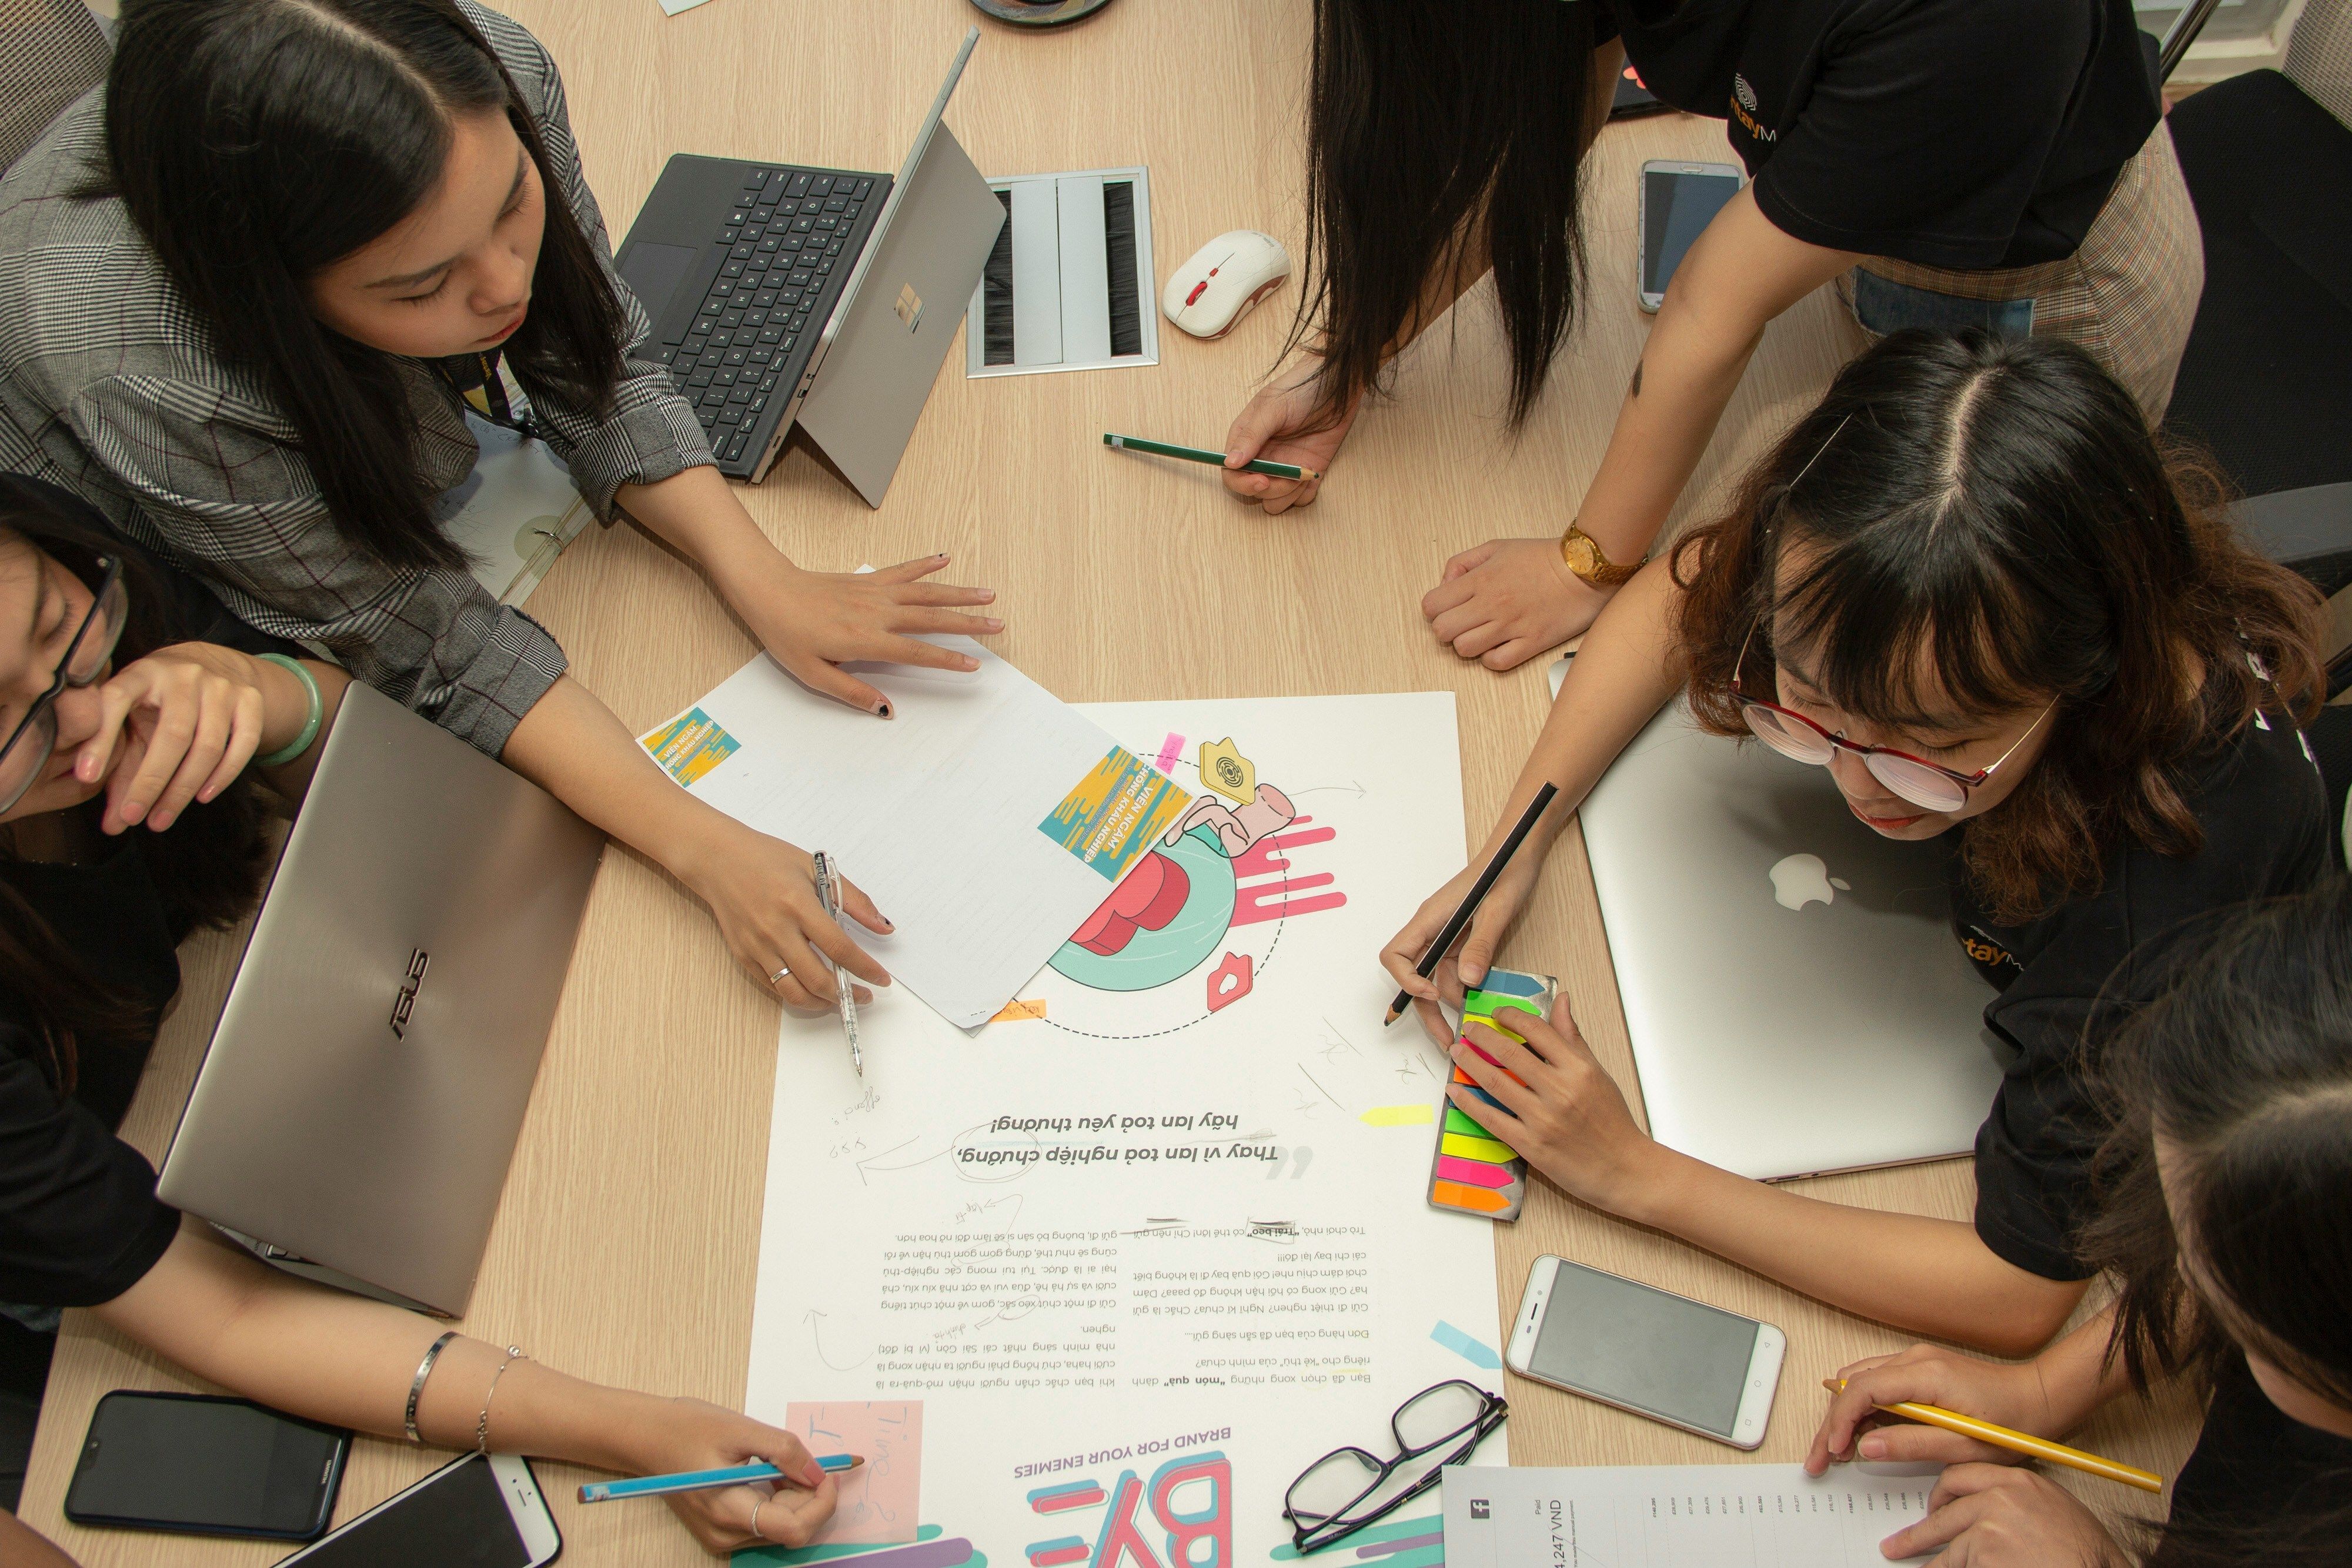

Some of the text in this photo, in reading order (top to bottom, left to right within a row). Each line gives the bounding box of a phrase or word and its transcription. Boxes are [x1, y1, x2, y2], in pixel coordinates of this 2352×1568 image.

[664, 744, 680, 758] VIÊN
[1107, 796, 1130, 828] KHẨU
[1107, 785, 1154, 850] VIÊN NGẬM
[1084, 824, 1111, 864] NGHIỆP
[389, 947, 430, 1043] ASUS
[990, 1111, 1239, 1134] hãy lan toả yêu thương!
[957, 1143, 1279, 1166] Thay vì lan toả nghiệp chướng,
[1133, 1305, 1149, 1316] gửi
[1152, 1306, 1161, 1315] là
[1165, 1306, 1191, 1316] Chắc
[1194, 1306, 1224, 1315] chưa?
[1227, 1306, 1236, 1314] kĩ
[1240, 1303, 1264, 1314] Nghĩ
[1268, 1302, 1307, 1313] nghen?
[1311, 1303, 1334, 1313] thiệt
[1351, 1303, 1368, 1313] Gửi
[1080, 1324, 1115, 1335] nghen.
[1275, 1329, 1294, 1340] bạn
[1318, 1329, 1345, 1339] hàng
[1348, 1330, 1369, 1339] Đơn
[1212, 1330, 1237, 1340] sàng
[1240, 1332, 1257, 1342] sẵn
[1259, 1332, 1272, 1340] đã
[1297, 1330, 1316, 1340] của
[878, 1344, 898, 1355] đốt)
[904, 1344, 913, 1354] bị
[936, 1345, 957, 1353] Gòn
[963, 1345, 977, 1353] Sài
[983, 1345, 997, 1353] cái
[1003, 1344, 1027, 1353] nhất
[1033, 1342, 1057, 1352] sáng
[1063, 1343, 1090, 1352] mình
[1096, 1343, 1115, 1352] nhà
[888, 1361, 913, 1370] xong
[956, 1360, 985, 1371] người
[988, 1360, 1010, 1371] phải
[1041, 1361, 1061, 1370] chứ
[1064, 1360, 1091, 1370] haha,
[1094, 1360, 1115, 1370] cười
[1195, 1359, 1226, 1368] chưa?
[1228, 1359, 1255, 1368] mình
[1258, 1358, 1277, 1368] của
[1322, 1357, 1341, 1366] cho
[1344, 1355, 1370, 1366] riêng
[877, 1363, 886, 1372] là
[915, 1361, 941, 1372] nhận
[944, 1362, 954, 1370] ta
[1074, 1377, 1094, 1388] bạn
[1100, 1378, 1115, 1388] khi
[1132, 1378, 1159, 1387] dành
[1231, 1375, 1265, 1385] những
[1271, 1374, 1296, 1383] xong
[1301, 1374, 1327, 1384] chọn
[1332, 1375, 1345, 1384] đã
[1351, 1373, 1371, 1383] Bạn
[876, 1380, 884, 1390] là
[948, 1379, 975, 1389] nhận
[980, 1378, 1010, 1389] người
[1015, 1379, 1040, 1389] chắn
[1045, 1379, 1070, 1389] chắc
[1014, 1427, 1232, 1479] BRAND FOR YOUR ENEMIES
[1549, 1500, 1563, 1531] VND
